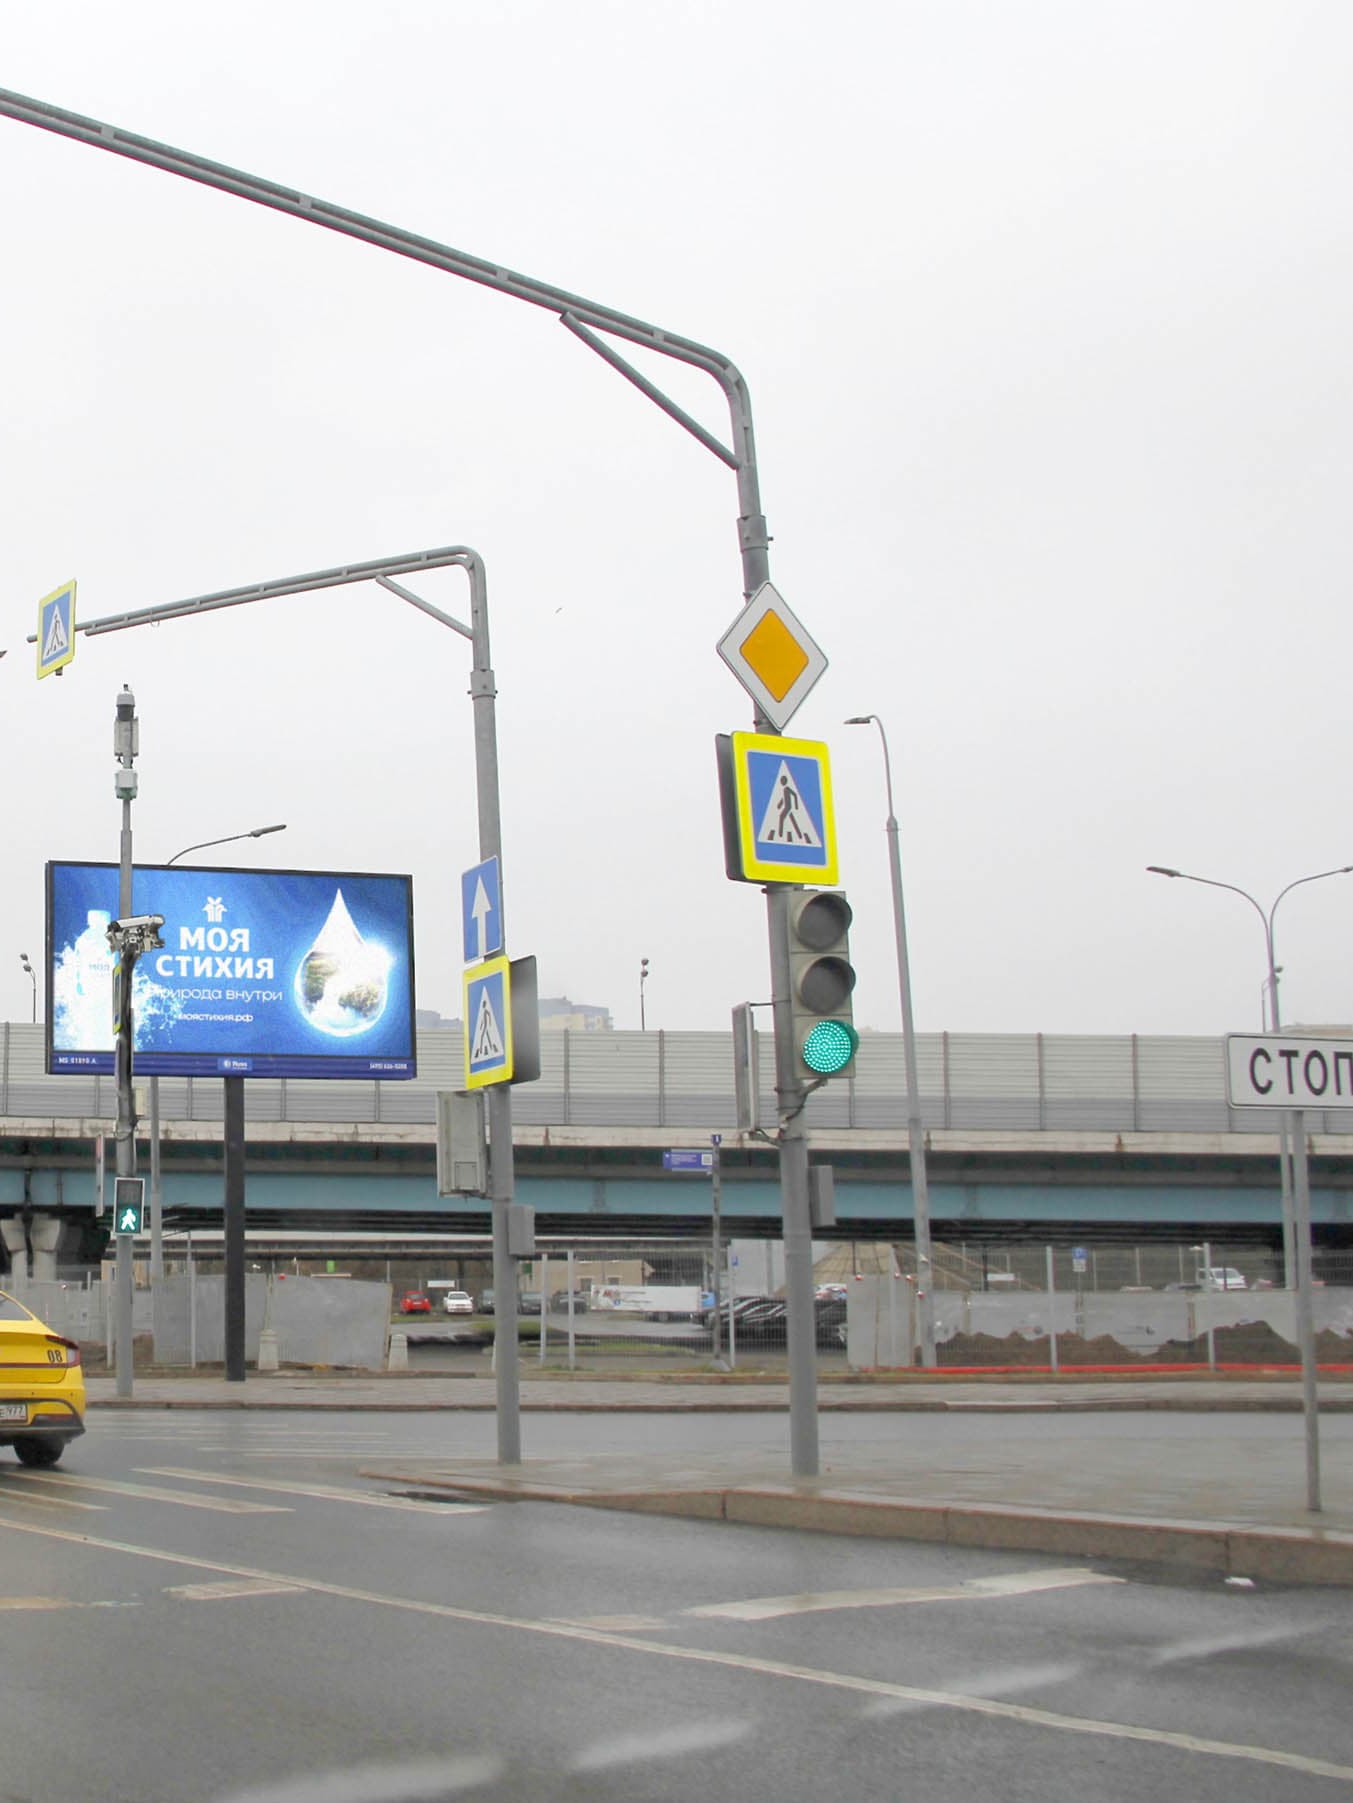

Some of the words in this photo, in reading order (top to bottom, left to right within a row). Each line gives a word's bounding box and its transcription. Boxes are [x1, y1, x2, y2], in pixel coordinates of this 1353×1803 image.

[179, 926, 250, 953] МОЯ
[155, 954, 274, 979] СТИХИЯ
[225, 989, 283, 1004] внутри
[1249, 1047, 1353, 1095] СТОП
[47, 1349, 63, 1363] 08
